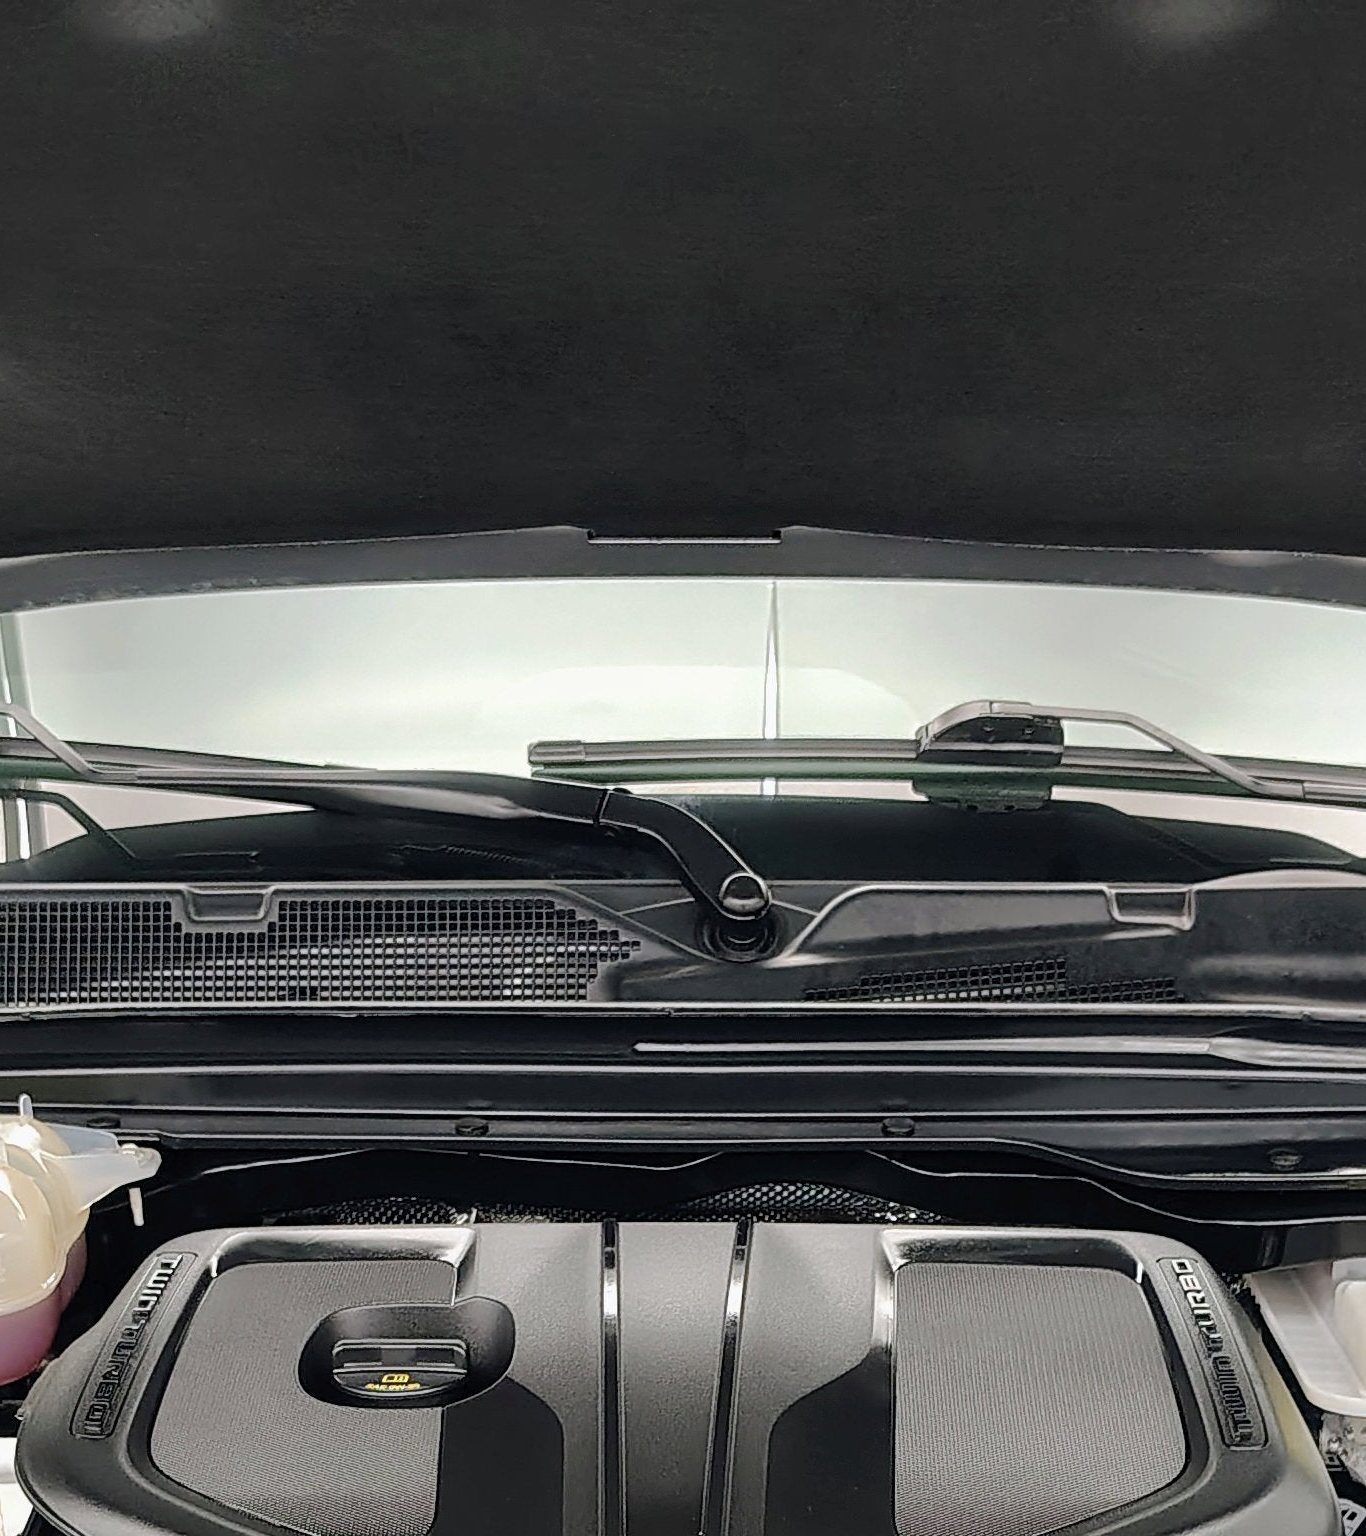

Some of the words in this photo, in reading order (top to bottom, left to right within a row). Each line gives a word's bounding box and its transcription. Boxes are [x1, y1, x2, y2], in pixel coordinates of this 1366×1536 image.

[133, 1254, 184, 1314] TWIN
[1171, 1258, 1224, 1352] TURBO
[84, 1319, 146, 1425] TURBO
[1211, 1354, 1254, 1439] TWIN
